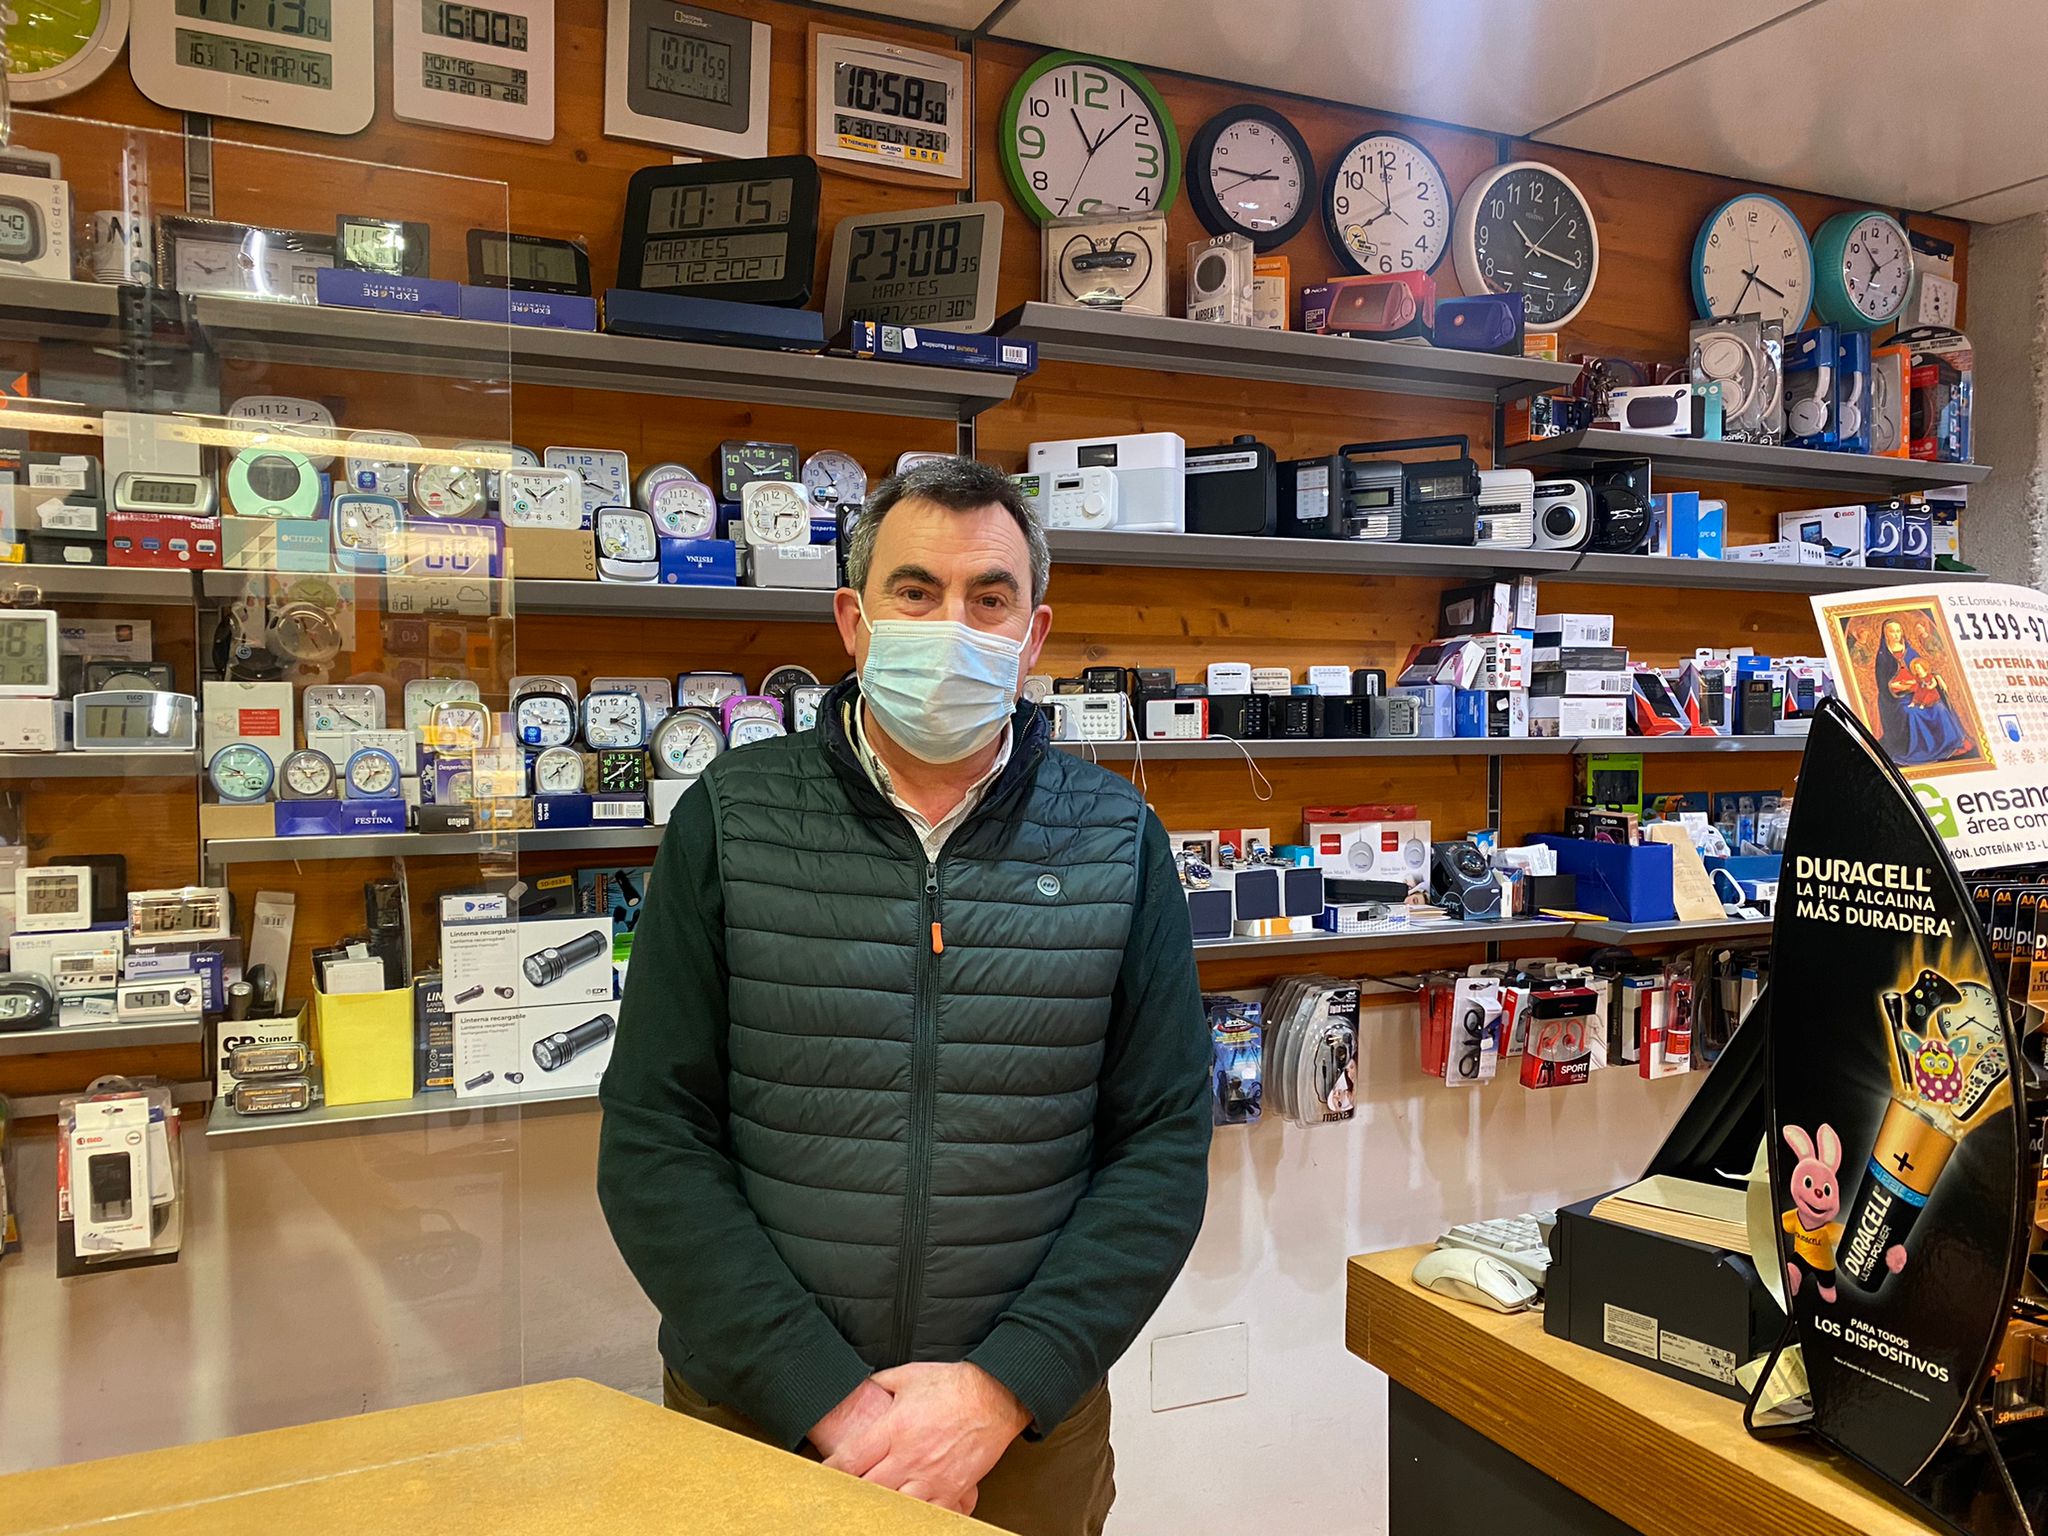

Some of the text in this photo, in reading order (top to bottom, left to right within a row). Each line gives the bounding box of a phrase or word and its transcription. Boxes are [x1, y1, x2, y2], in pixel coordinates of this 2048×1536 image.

[307, 16, 328, 38] 04
[438, 4, 510, 47] 16:00
[425, 55, 475, 76] MONTAG
[847, 66, 924, 119] 10:58
[1055, 77, 1066, 98] 11
[1072, 71, 1109, 110] 12
[1030, 97, 1050, 118] 10
[1120, 89, 1125, 108] 1
[924, 100, 945, 125] 50
[837, 119, 909, 148] 6/30 SUN
[1134, 115, 1149, 136] 2
[1248, 127, 1260, 136] 12
[1018, 125, 1046, 159] 9
[1230, 132, 1239, 140] 11
[880, 146, 901, 154] CASIO
[1217, 147, 1228, 155] 10
[1134, 143, 1159, 179] 3
[1282, 156, 1290, 165] 2
[1360, 154, 1374, 174] 11
[1377, 150, 1397, 171] 12
[1342, 170, 1364, 191] 10
[1405, 162, 1412, 181] 1
[1033, 171, 1049, 191] 8
[1288, 179, 1297, 187] 3
[1135, 186, 1150, 206] 4
[1417, 182, 1430, 201] 2
[1507, 183, 1521, 205] 11
[1528, 181, 1543, 203] 12
[670, 181, 772, 230] 10:15
[1055, 198, 1069, 216] 7
[1336, 195, 1349, 215] 9
[1490, 199, 1505, 221] 10
[1553, 196, 1560, 216] 1
[1231, 211, 1239, 219] 7
[1424, 209, 1436, 228] 3
[1727, 216, 1735, 228] 11
[1748, 211, 1758, 223] 12
[1479, 225, 1489, 246] 9
[1567, 219, 1577, 239] 2
[1770, 223, 1777, 234] 1
[1861, 230, 1868, 242] 11
[1870, 227, 1880, 239] 12
[1415, 234, 1429, 253] 4
[1709, 233, 1720, 249] 10
[1886, 233, 1890, 244] 1
[645, 237, 729, 264] MARTES
[849, 221, 961, 283] 23:08
[1783, 249, 1792, 258] 2
[1850, 243, 1860, 255] 10
[1894, 248, 1900, 259] 2
[960, 256, 977, 274] 35
[1379, 254, 1393, 274] 6
[1401, 250, 1414, 269] 5
[1485, 257, 1495, 278] 8
[1573, 249, 1582, 270] 3
[1846, 261, 1852, 271] 9
[1703, 265, 1711, 275] 9
[1896, 268, 1902, 278] 3
[872, 280, 939, 300] MARTES
[1562, 277, 1577, 297] 4
[1788, 279, 1798, 288] 3
[1849, 280, 1855, 290] 8
[1891, 286, 1898, 295] 4
[363, 288, 419, 302] EXPLORE
[1545, 292, 1556, 312] 5
[1707, 296, 1717, 307] 8
[1858, 293, 1864, 304] 7
[1882, 297, 1888, 307] 5
[511, 304, 551, 315] EXPLORE
[881, 305, 937, 323] 27/SEP
[1782, 307, 1790, 318] 4
[1870, 300, 1875, 311] 6
[866, 327, 876, 349] TFA
[685, 555, 713, 564] FESTINA
[1973, 655, 2035, 669] LOTERÍA
[2006, 675, 2026, 686] DE
[1995, 692, 2024, 704] 22 de
[355, 816, 393, 825] FESTINA
[1967, 817, 2010, 834] área
[1974, 841, 2013, 857] LOTERÍA
[2026, 840, 2035, 851] 13
[1797, 855, 1931, 892] DURACELL
[1796, 881, 1936, 912] LA PILA ALCALINA
[1976, 888, 1990, 899] AA
[1996, 891, 2012, 902] AA
[2021, 894, 2035, 905] AA
[477, 901, 501, 912] gsc
[1796, 898, 1841, 922] MÁS
[450, 928, 517, 938] Linterna recargable
[128, 960, 158, 968] CASIO
[460, 1013, 527, 1024] Linterna recargable
[1560, 1062, 1588, 1075] SPORT
[1844, 1188, 1893, 1277] DURACELL
[1859, 1225, 1893, 1283] ULTRA POWER
[1850, 1318, 1910, 1350] PARA TODOS
[1814, 1314, 1842, 1337] LOS
[1845, 1329, 1951, 1383] DISPOSITIVOS
